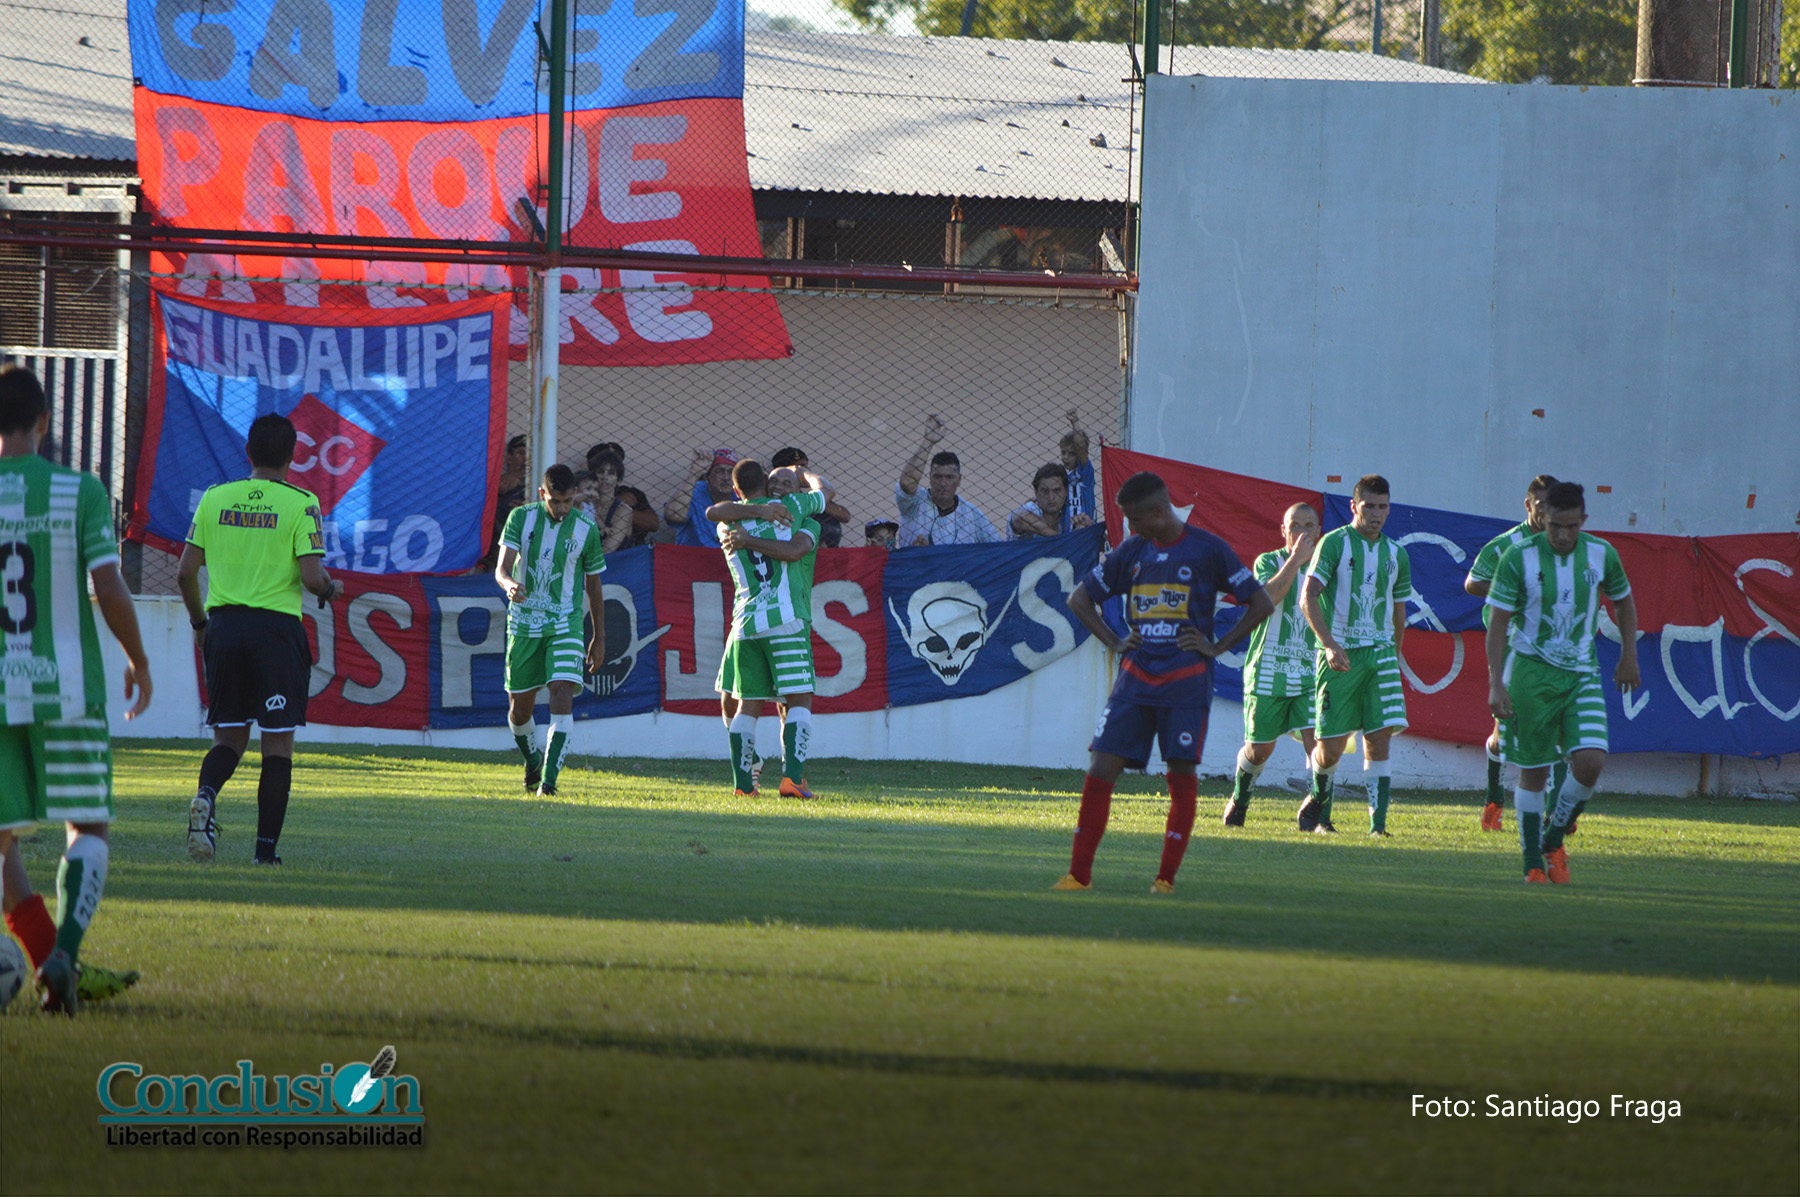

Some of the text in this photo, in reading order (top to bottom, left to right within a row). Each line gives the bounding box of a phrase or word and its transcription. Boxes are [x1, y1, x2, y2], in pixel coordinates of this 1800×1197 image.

[155, 107, 688, 243] PARQUE
[163, 304, 492, 394] GUADALUPE
[231, 503, 274, 512] ATHIX
[221, 510, 277, 528] LA NUEVA
[524, 599, 563, 614] IRADOR
[1139, 620, 1180, 637] ndar
[1342, 627, 1387, 640] MIRADOR
